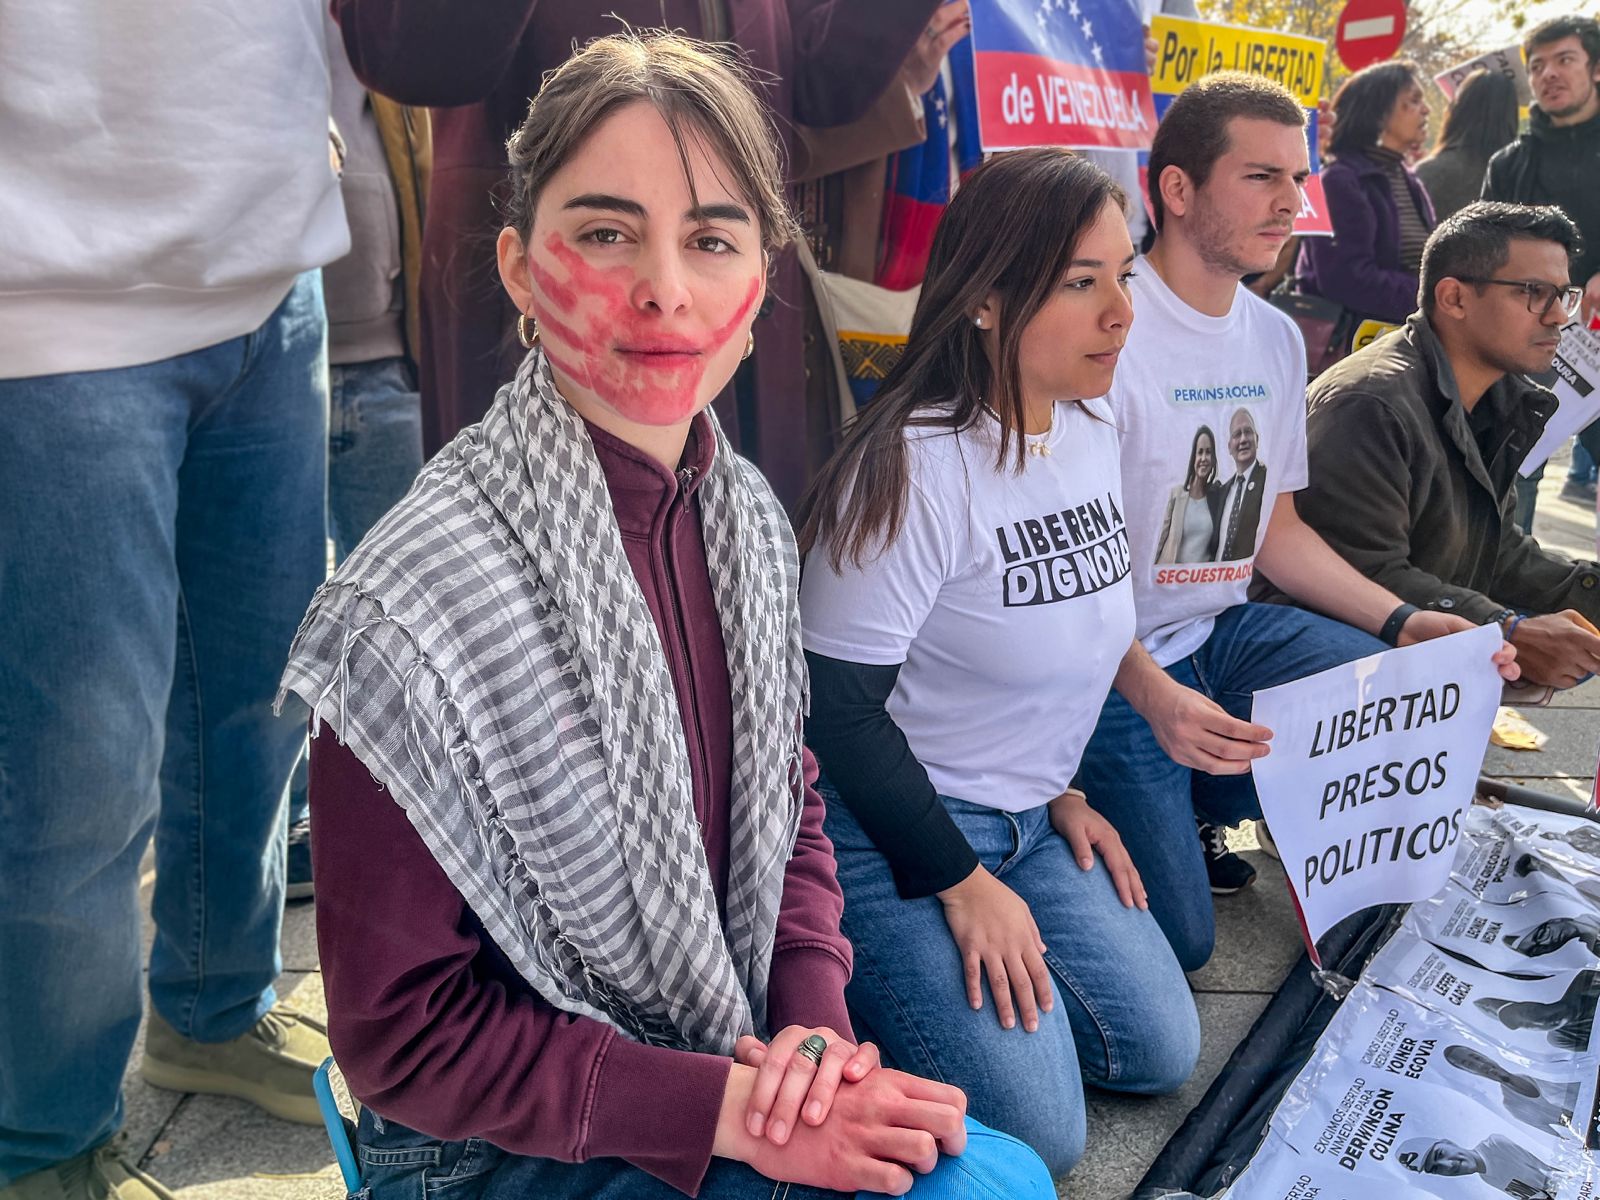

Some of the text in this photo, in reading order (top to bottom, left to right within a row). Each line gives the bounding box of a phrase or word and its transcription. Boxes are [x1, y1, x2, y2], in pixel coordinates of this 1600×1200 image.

[1159, 31, 1317, 96] Por la LIBERTAD
[1001, 73, 1149, 133] de VENEZUELA
[1174, 384, 1266, 402] PERKINS ROCHA
[995, 491, 1124, 564] LIBEREN A
[1007, 530, 1131, 605] DIGNORA
[1308, 682, 1460, 759] LIBERTAD
[1319, 751, 1448, 821] PRESOS
[1305, 808, 1462, 898] POLITICOS
[1385, 1038, 1418, 1075] YOINER
[1389, 1021, 1408, 1047] PARA
[1405, 1040, 1438, 1079] EGOVIA
[1313, 1108, 1346, 1154] EXIGIMOS
[1328, 1089, 1375, 1157] INMEDIATA PARA
[1339, 1088, 1394, 1171] DERWINSON
[1369, 1113, 1406, 1161] COLINA
